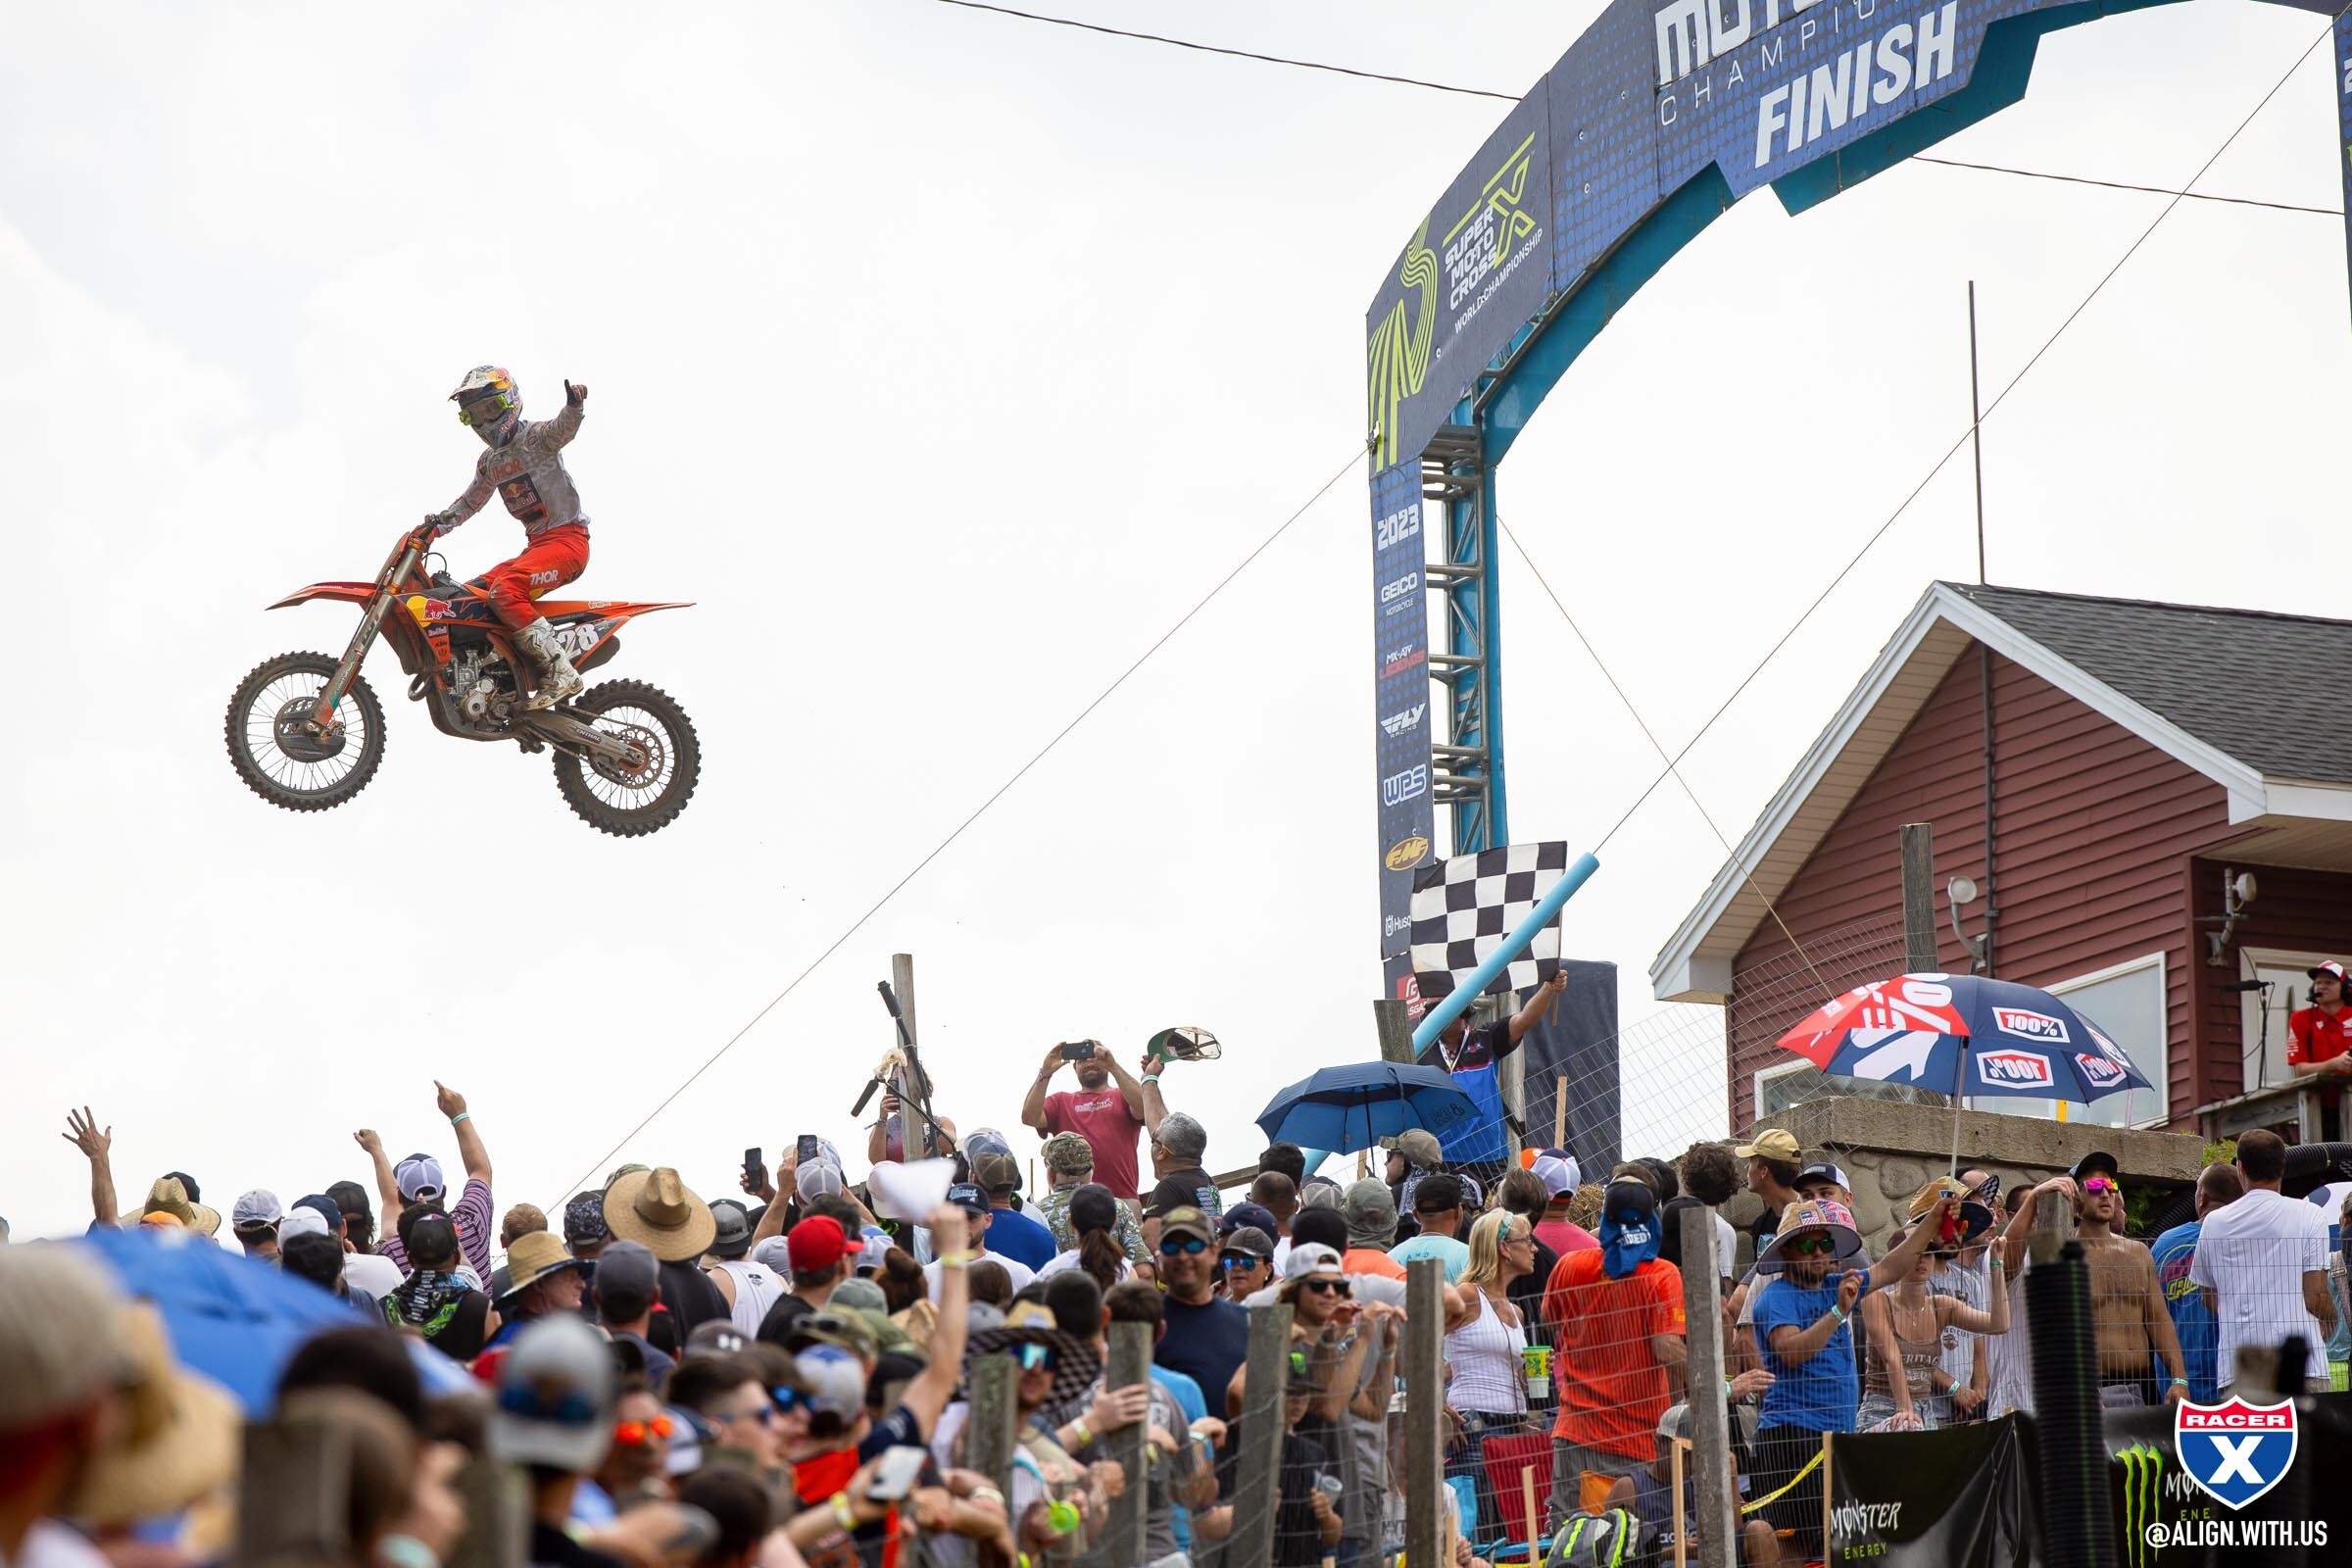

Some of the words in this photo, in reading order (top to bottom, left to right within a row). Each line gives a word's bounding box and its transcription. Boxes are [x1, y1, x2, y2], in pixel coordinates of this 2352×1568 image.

[1660, 0, 1899, 126] CHAMPIO
[1754, 1, 1957, 169] FINISH
[1445, 205, 1494, 273] SUPER
[1450, 225, 1494, 288] MOTO
[1450, 243, 1497, 311] CROSS
[1454, 298, 1482, 334] WORLD
[1483, 227, 1544, 301] CHAMPIONSHIP
[492, 458, 523, 481] THOR
[1377, 503, 1420, 552] 2023
[530, 569, 559, 585] THOR
[1381, 571, 1418, 603] GEICO
[1386, 597, 1414, 617] MOTORCYCLE
[1381, 703, 1426, 734] FLY
[1390, 724, 1418, 738] RACING
[1383, 763, 1427, 807] WPS
[1387, 838, 1428, 868] FMF
[2005, 1014, 2058, 1037] 100%
[1831, 1497, 1902, 1539] MONSTER
[1844, 1542, 1886, 1559] ENERGY
